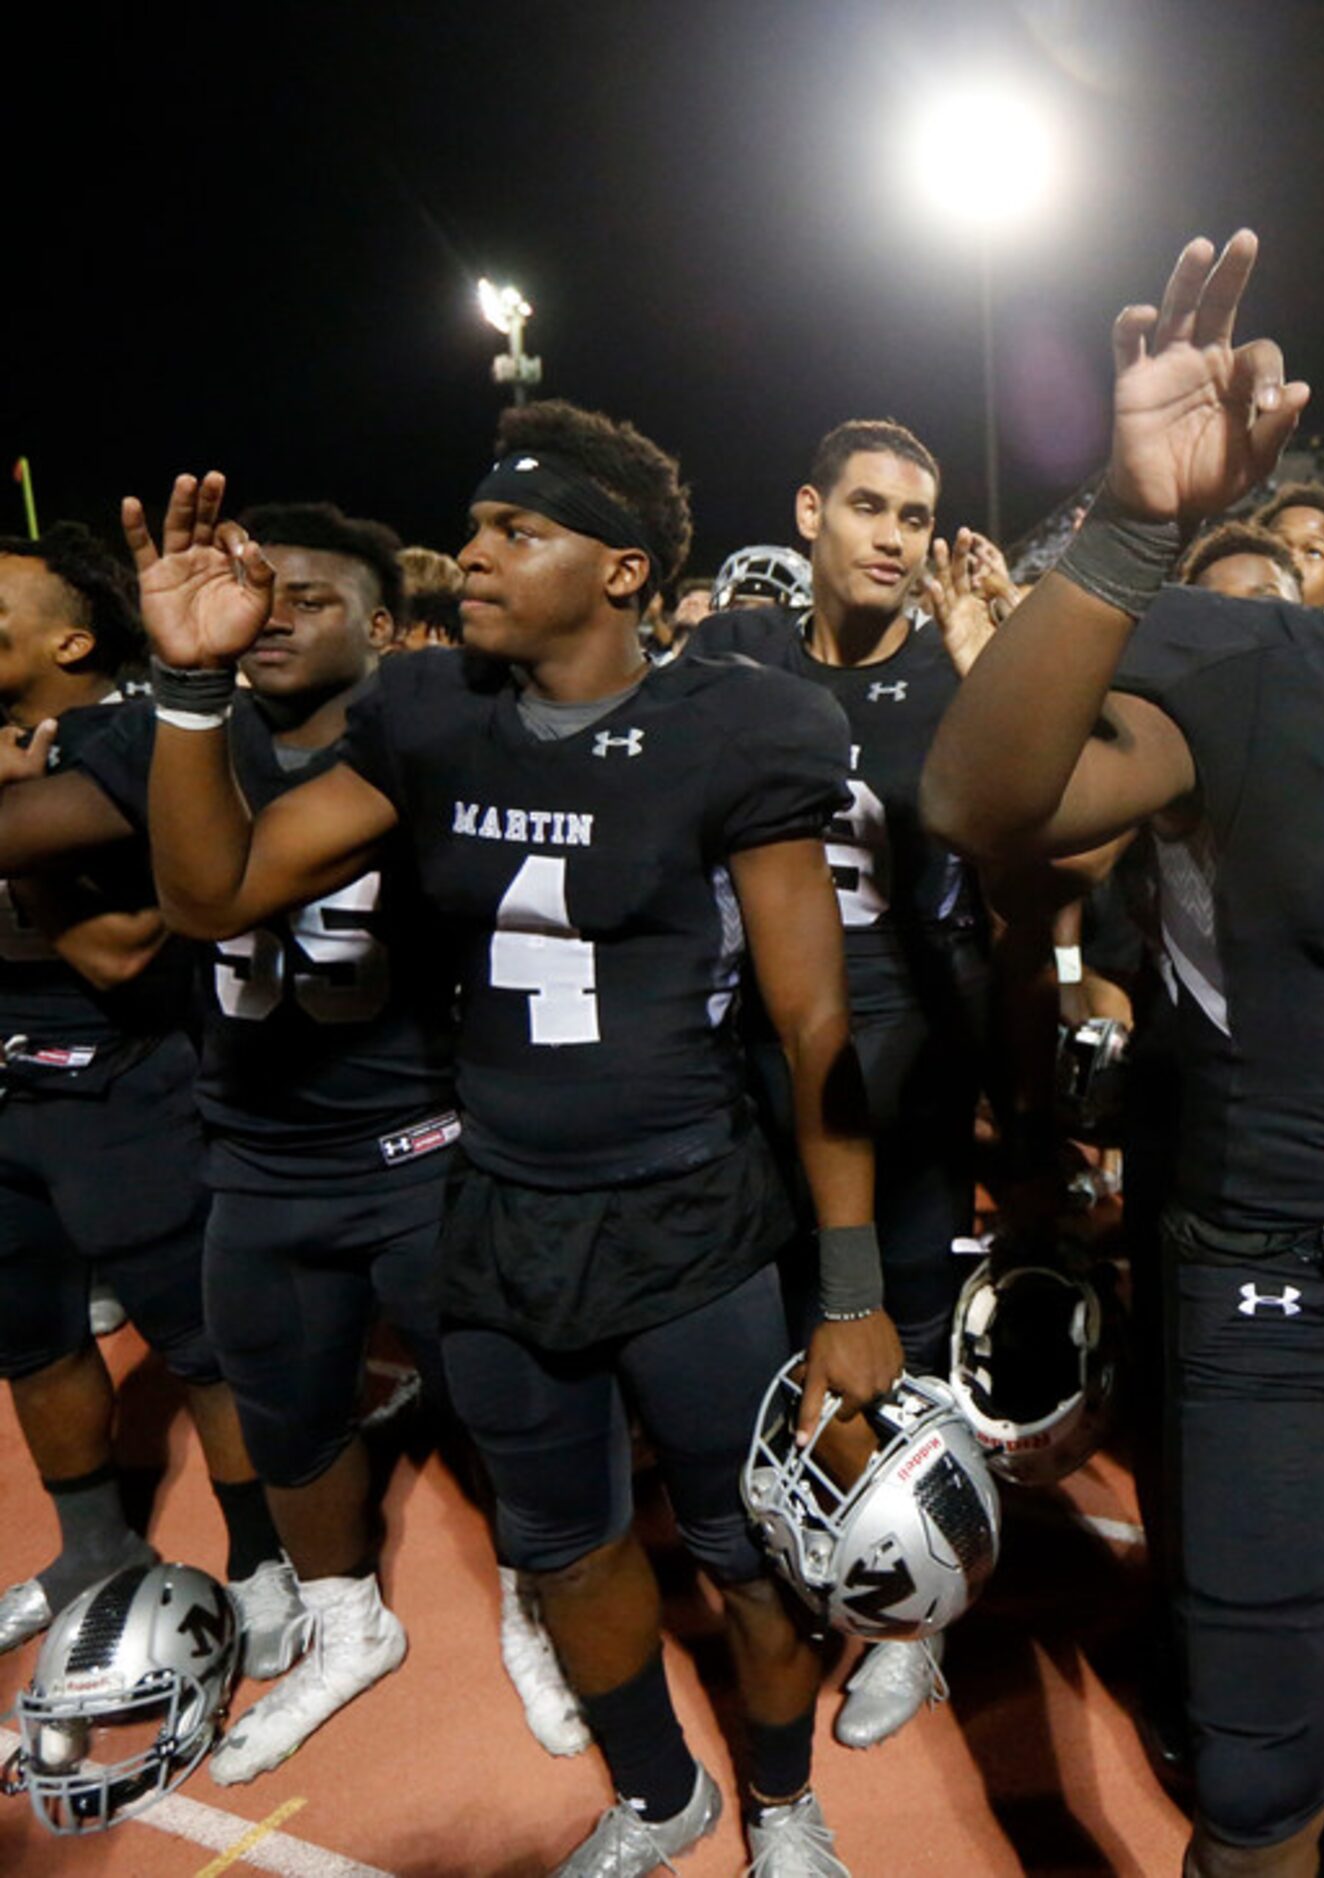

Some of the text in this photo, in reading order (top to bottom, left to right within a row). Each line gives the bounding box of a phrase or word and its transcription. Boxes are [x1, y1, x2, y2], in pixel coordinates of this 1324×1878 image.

[452, 801, 595, 847] MARTIN
[490, 854, 601, 1045] 4
[897, 1436, 942, 1482] Riddell
